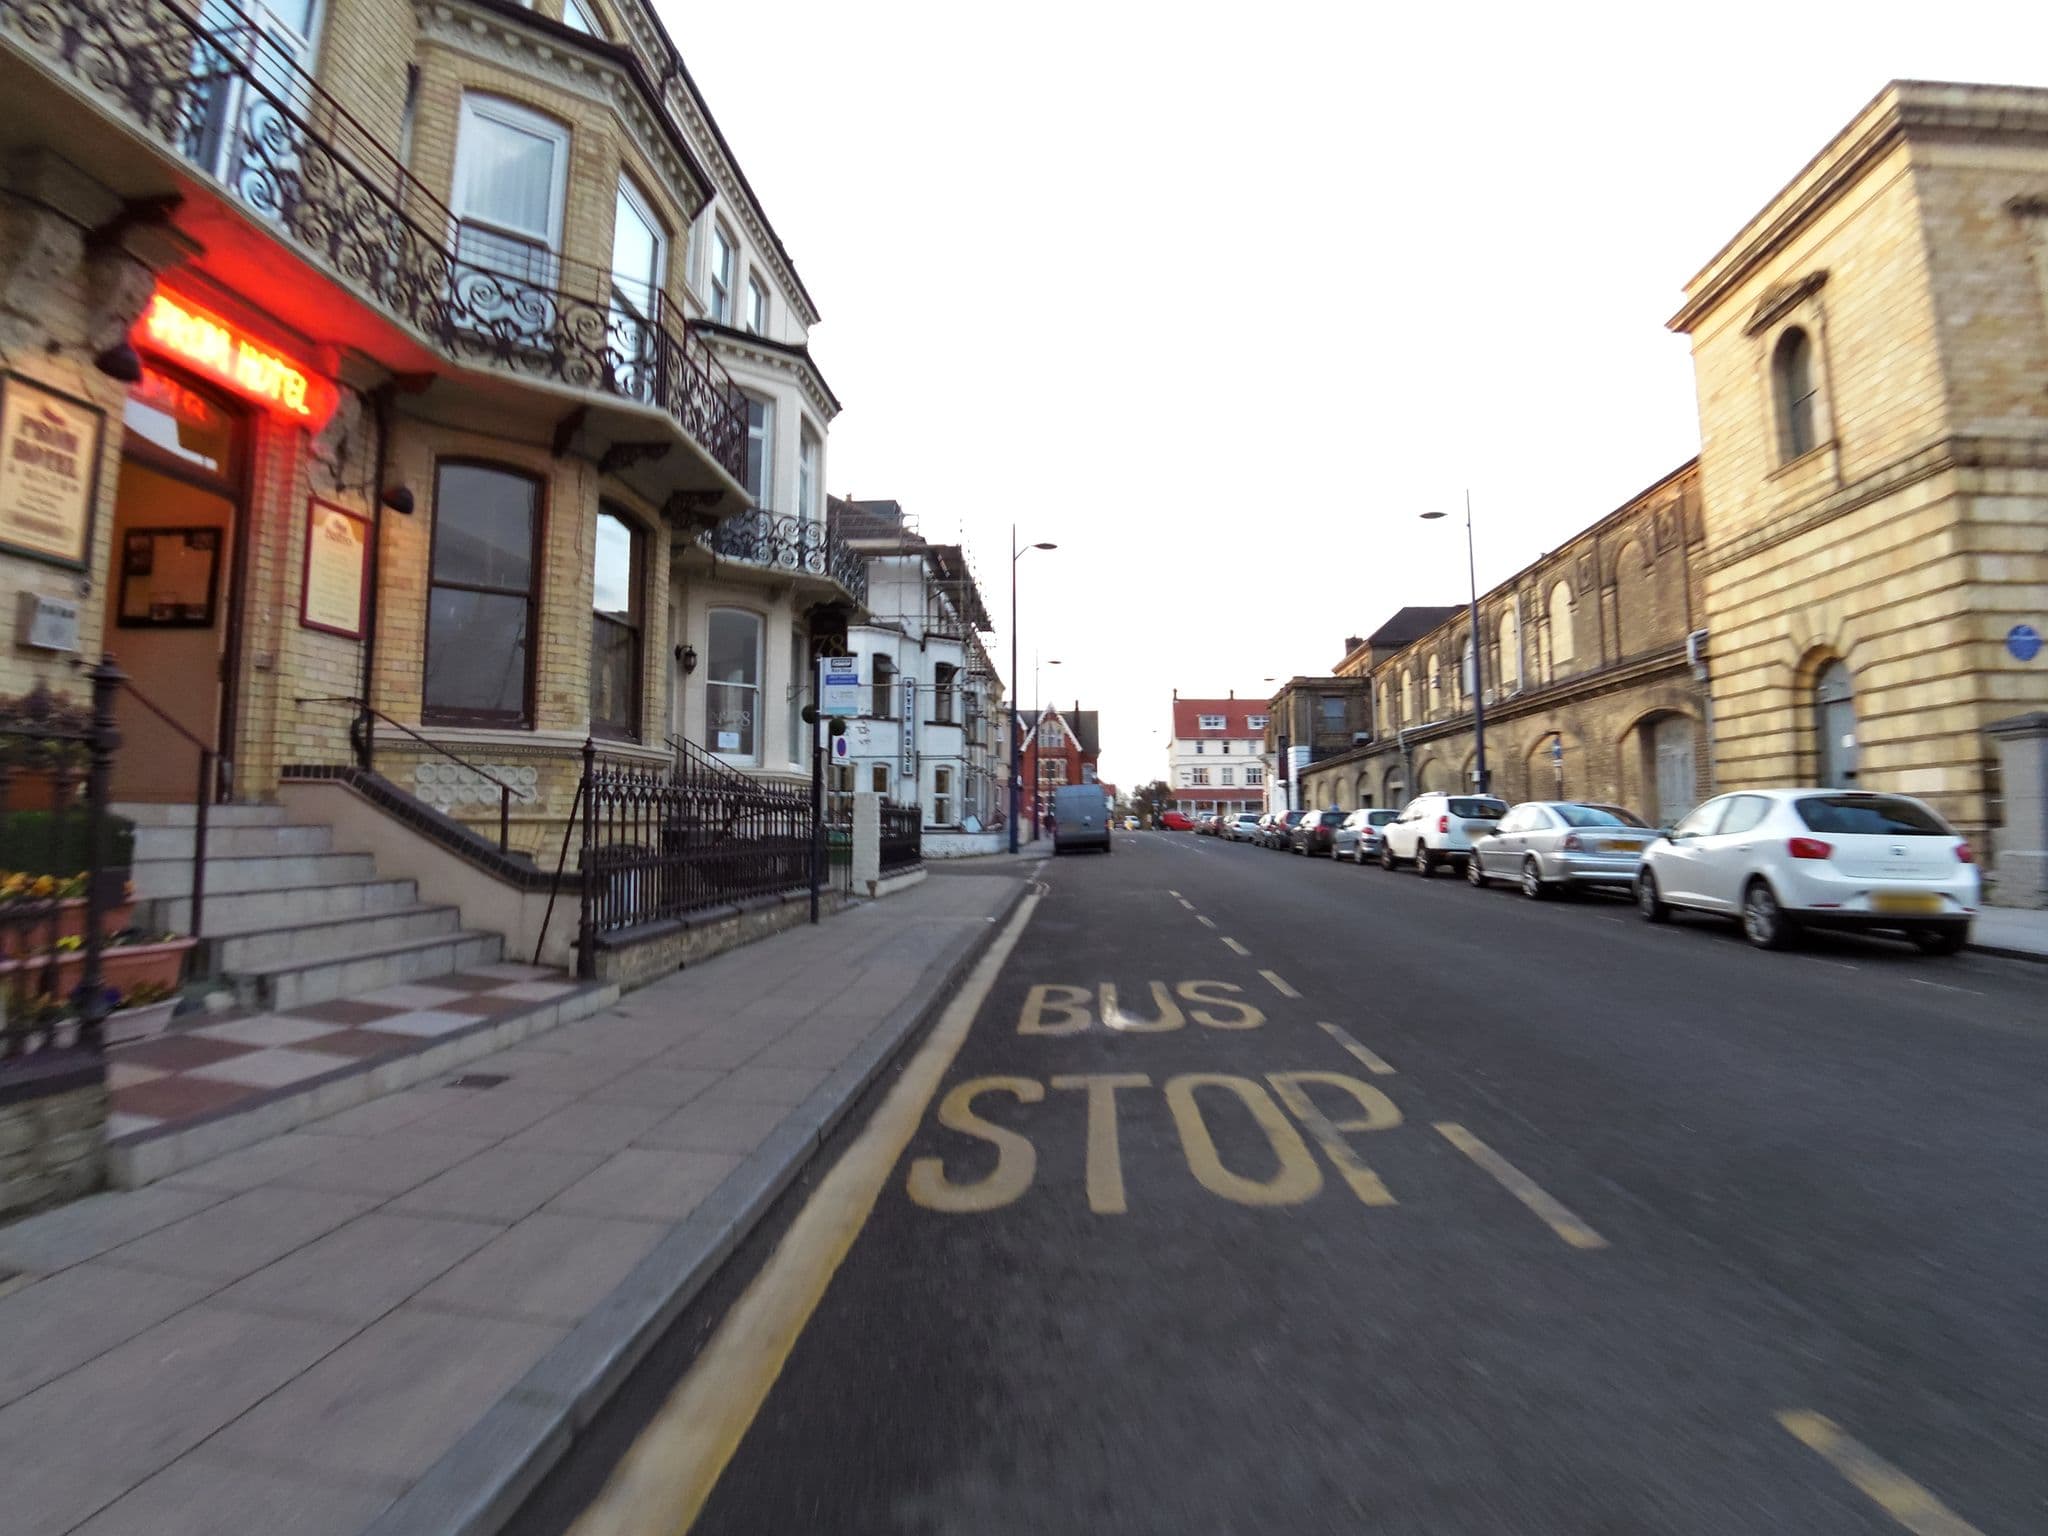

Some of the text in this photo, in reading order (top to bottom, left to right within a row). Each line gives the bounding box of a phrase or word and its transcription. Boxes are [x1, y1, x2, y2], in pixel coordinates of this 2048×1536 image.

[235, 339, 311, 415] HOTEL
[1016, 980, 1267, 1036] BUS
[906, 1071, 1405, 1215] STOP
